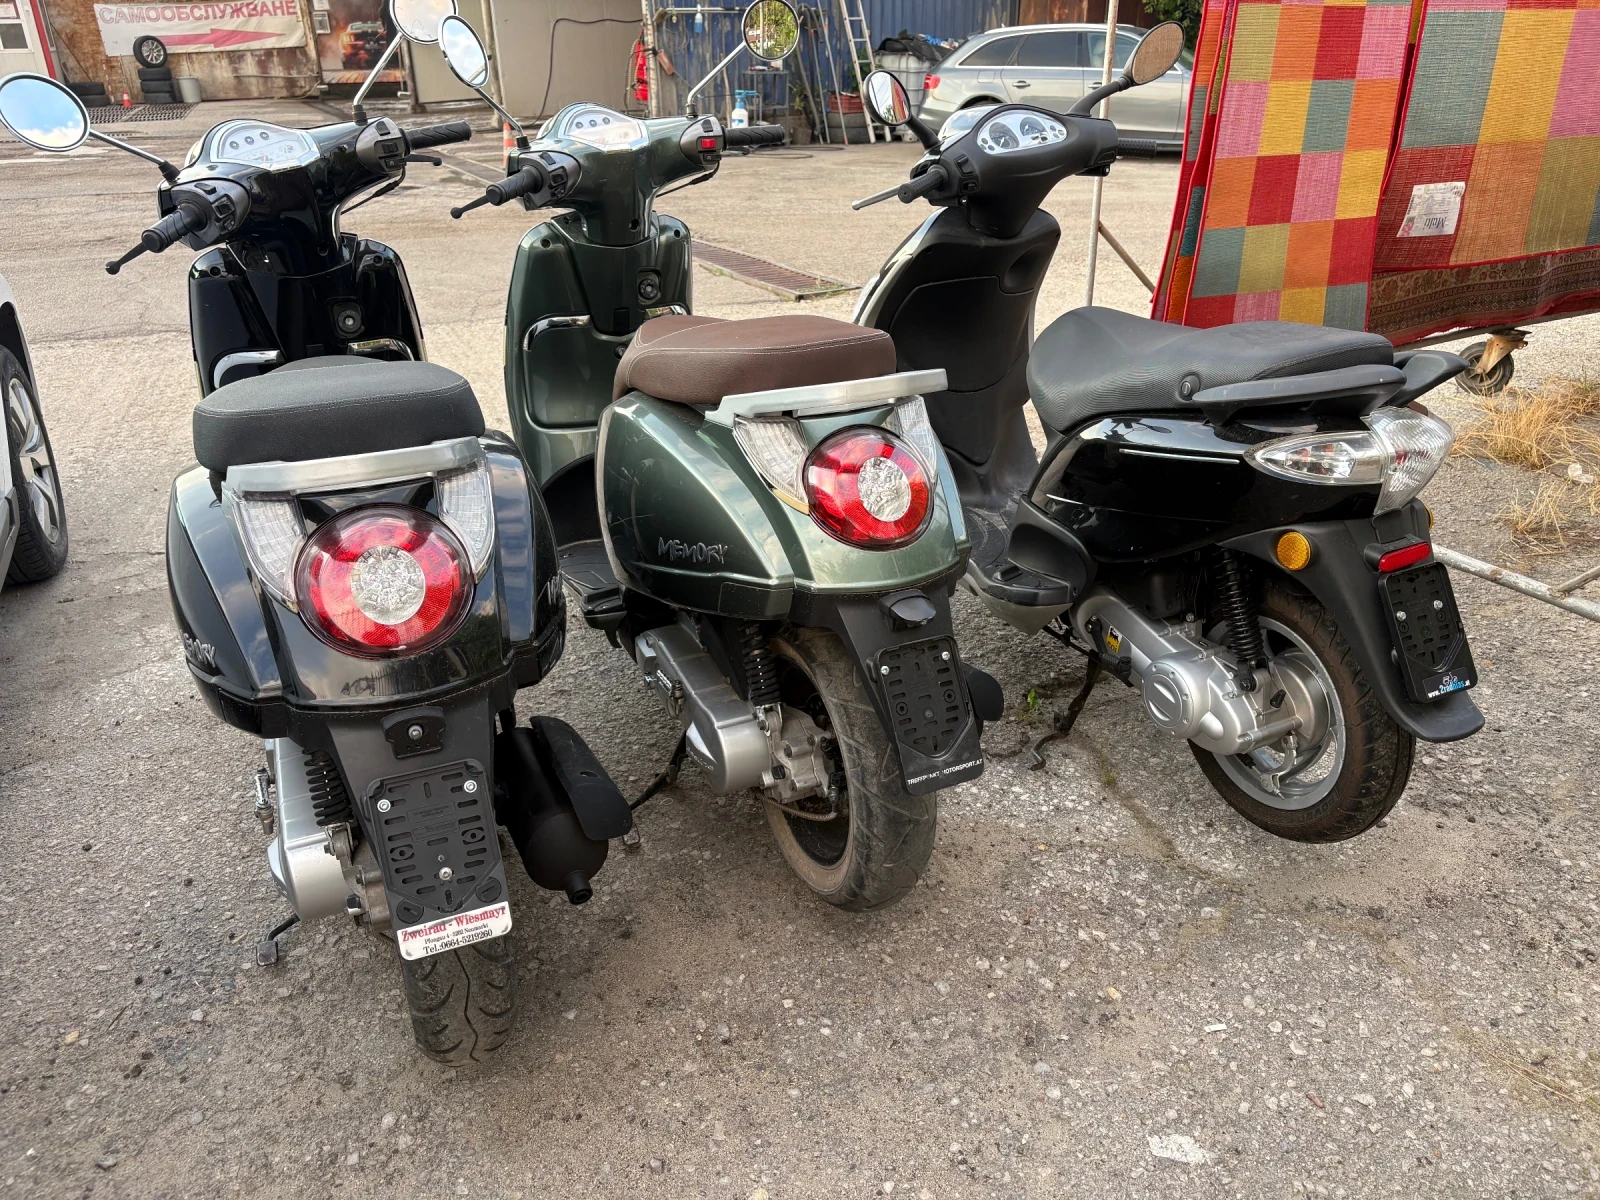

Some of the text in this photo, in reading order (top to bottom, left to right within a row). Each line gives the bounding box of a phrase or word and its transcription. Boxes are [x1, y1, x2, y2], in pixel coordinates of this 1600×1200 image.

[99, 0, 297, 24] САМООБСЛУЖВАНЕ
[658, 537, 728, 564] MEMORY
[907, 771, 940, 785] TREFFPNKT
[401, 921, 447, 942] Zweirad
[454, 906, 506, 927] Wiesmayr
